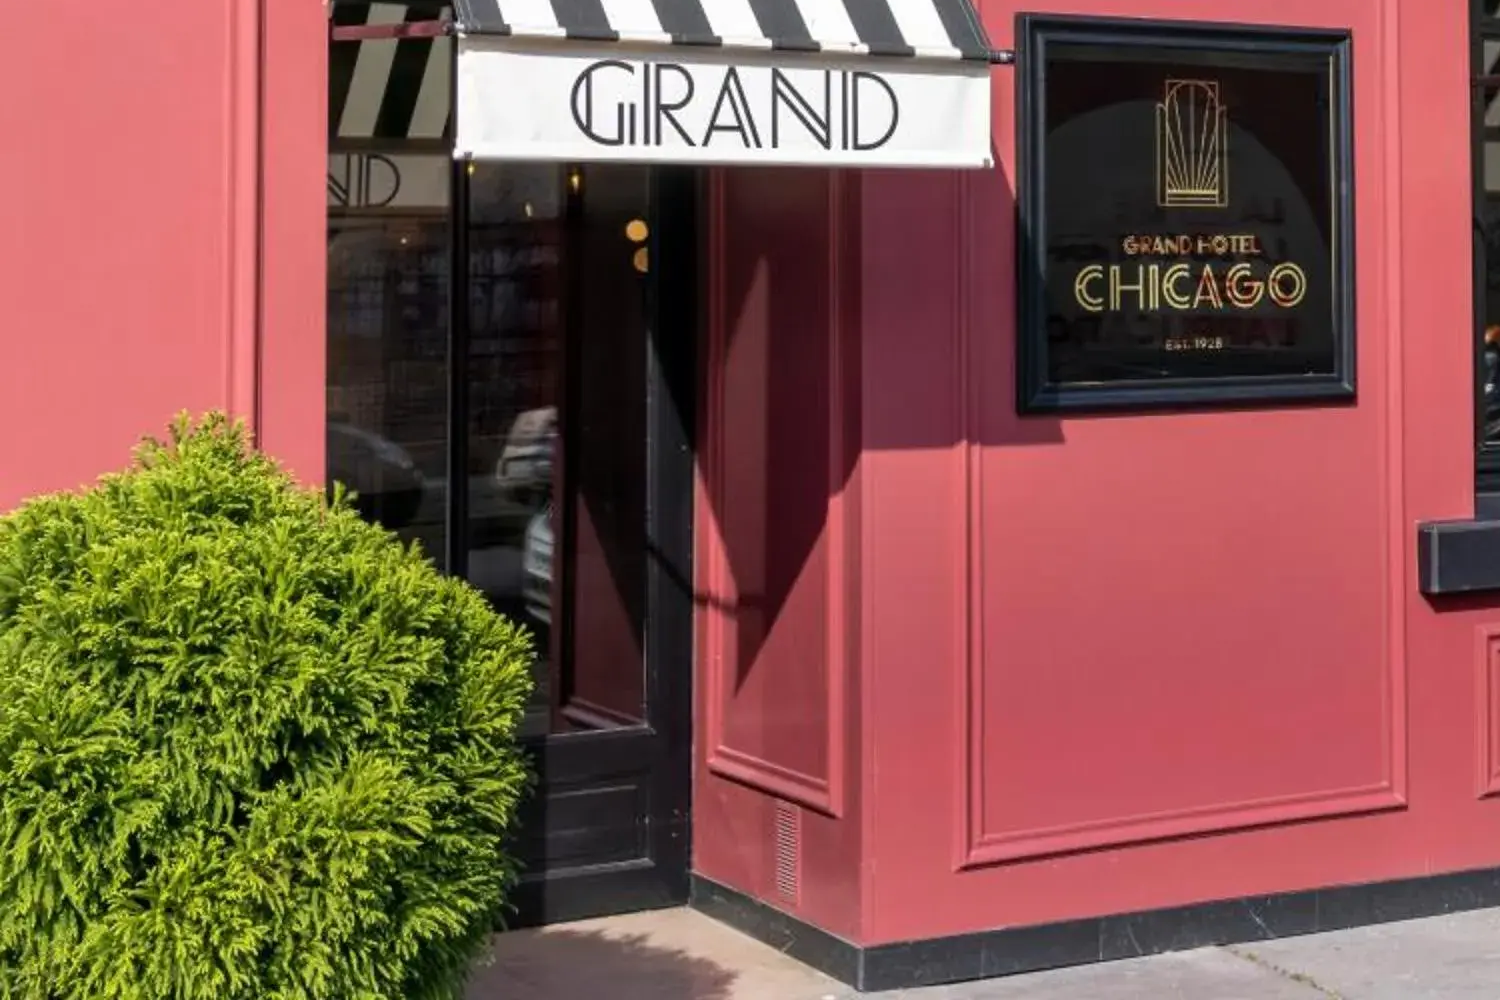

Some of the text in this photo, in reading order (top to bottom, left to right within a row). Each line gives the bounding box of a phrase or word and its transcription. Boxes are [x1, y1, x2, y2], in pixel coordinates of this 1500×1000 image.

[570, 59, 900, 152] GRAND
[1122, 234, 1261, 256] GRAND HOTEL
[1074, 262, 1308, 312] CHICAGO
[1194, 336, 1224, 351] 1928
